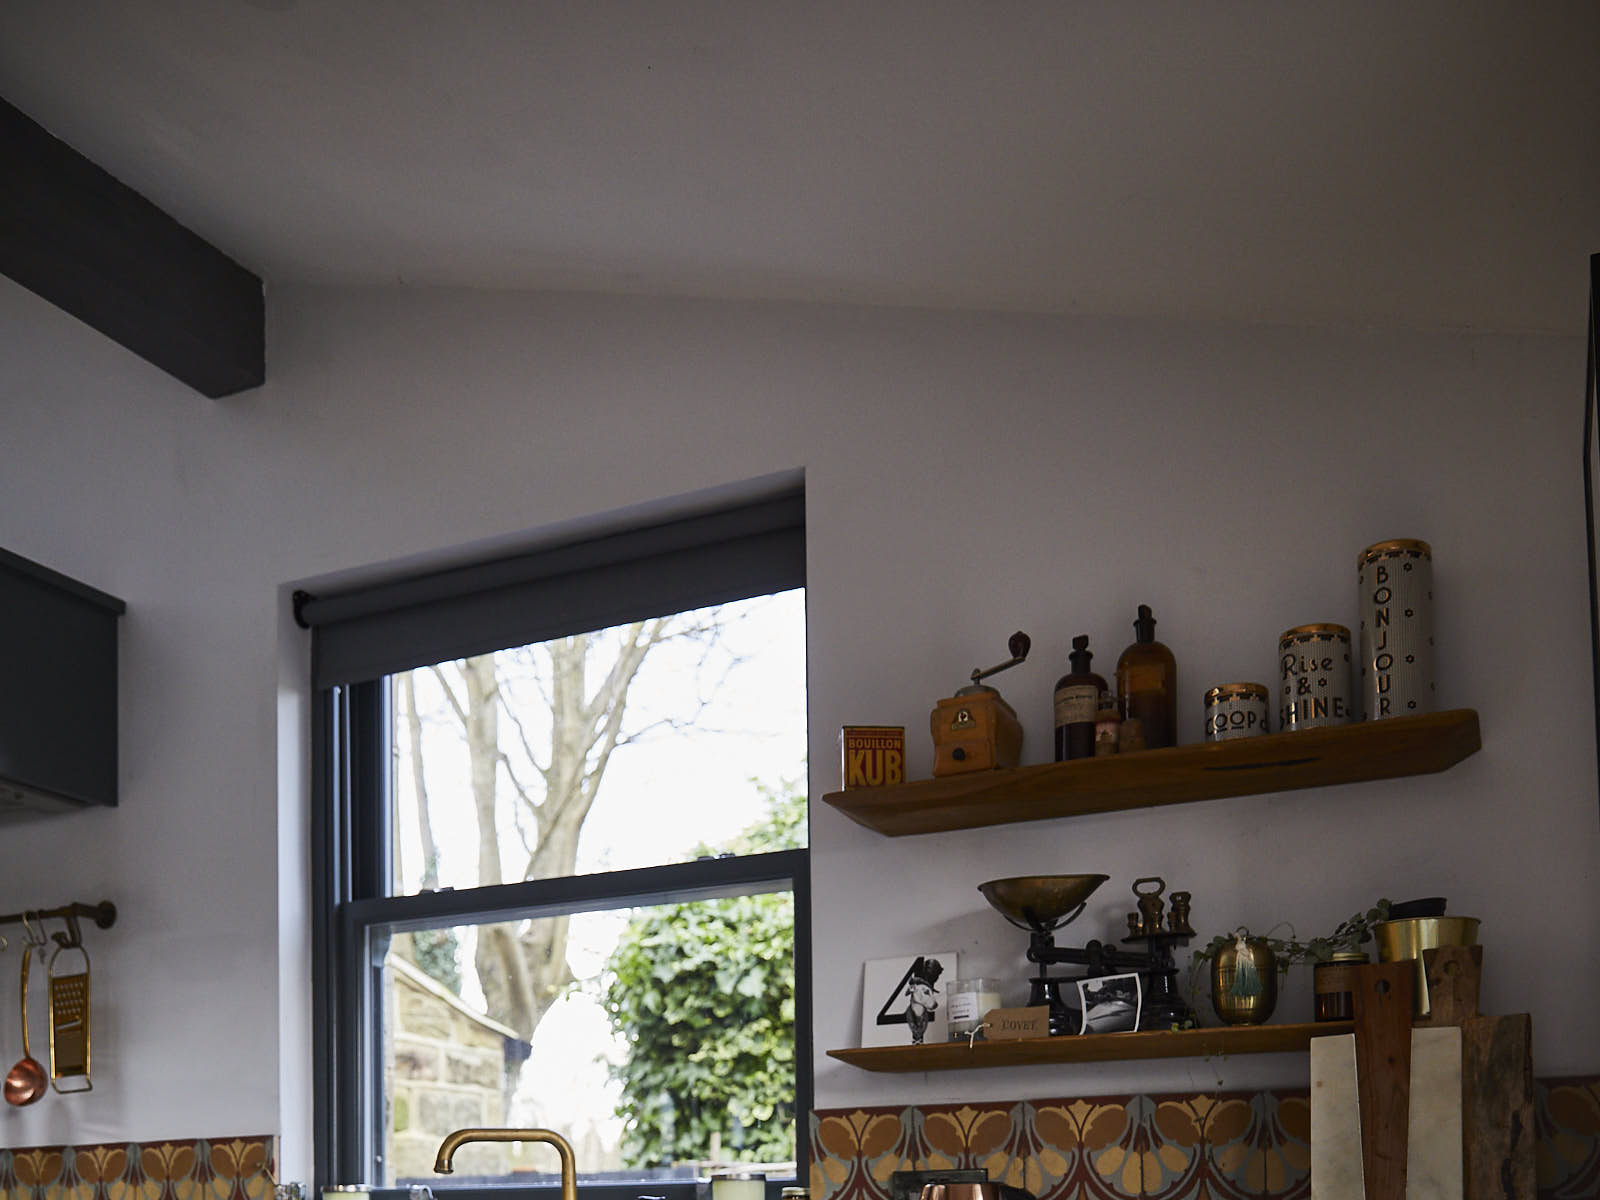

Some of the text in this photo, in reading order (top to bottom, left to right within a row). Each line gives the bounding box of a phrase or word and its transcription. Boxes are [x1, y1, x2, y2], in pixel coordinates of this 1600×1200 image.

[1374, 566, 1392, 715] BONJOUR
[1281, 654, 1333, 680] Rise
[1298, 677, 1311, 695] &
[1280, 697, 1343, 730] SHINE
[848, 739, 901, 749] BOUILLON
[848, 750, 901, 786] KUB
